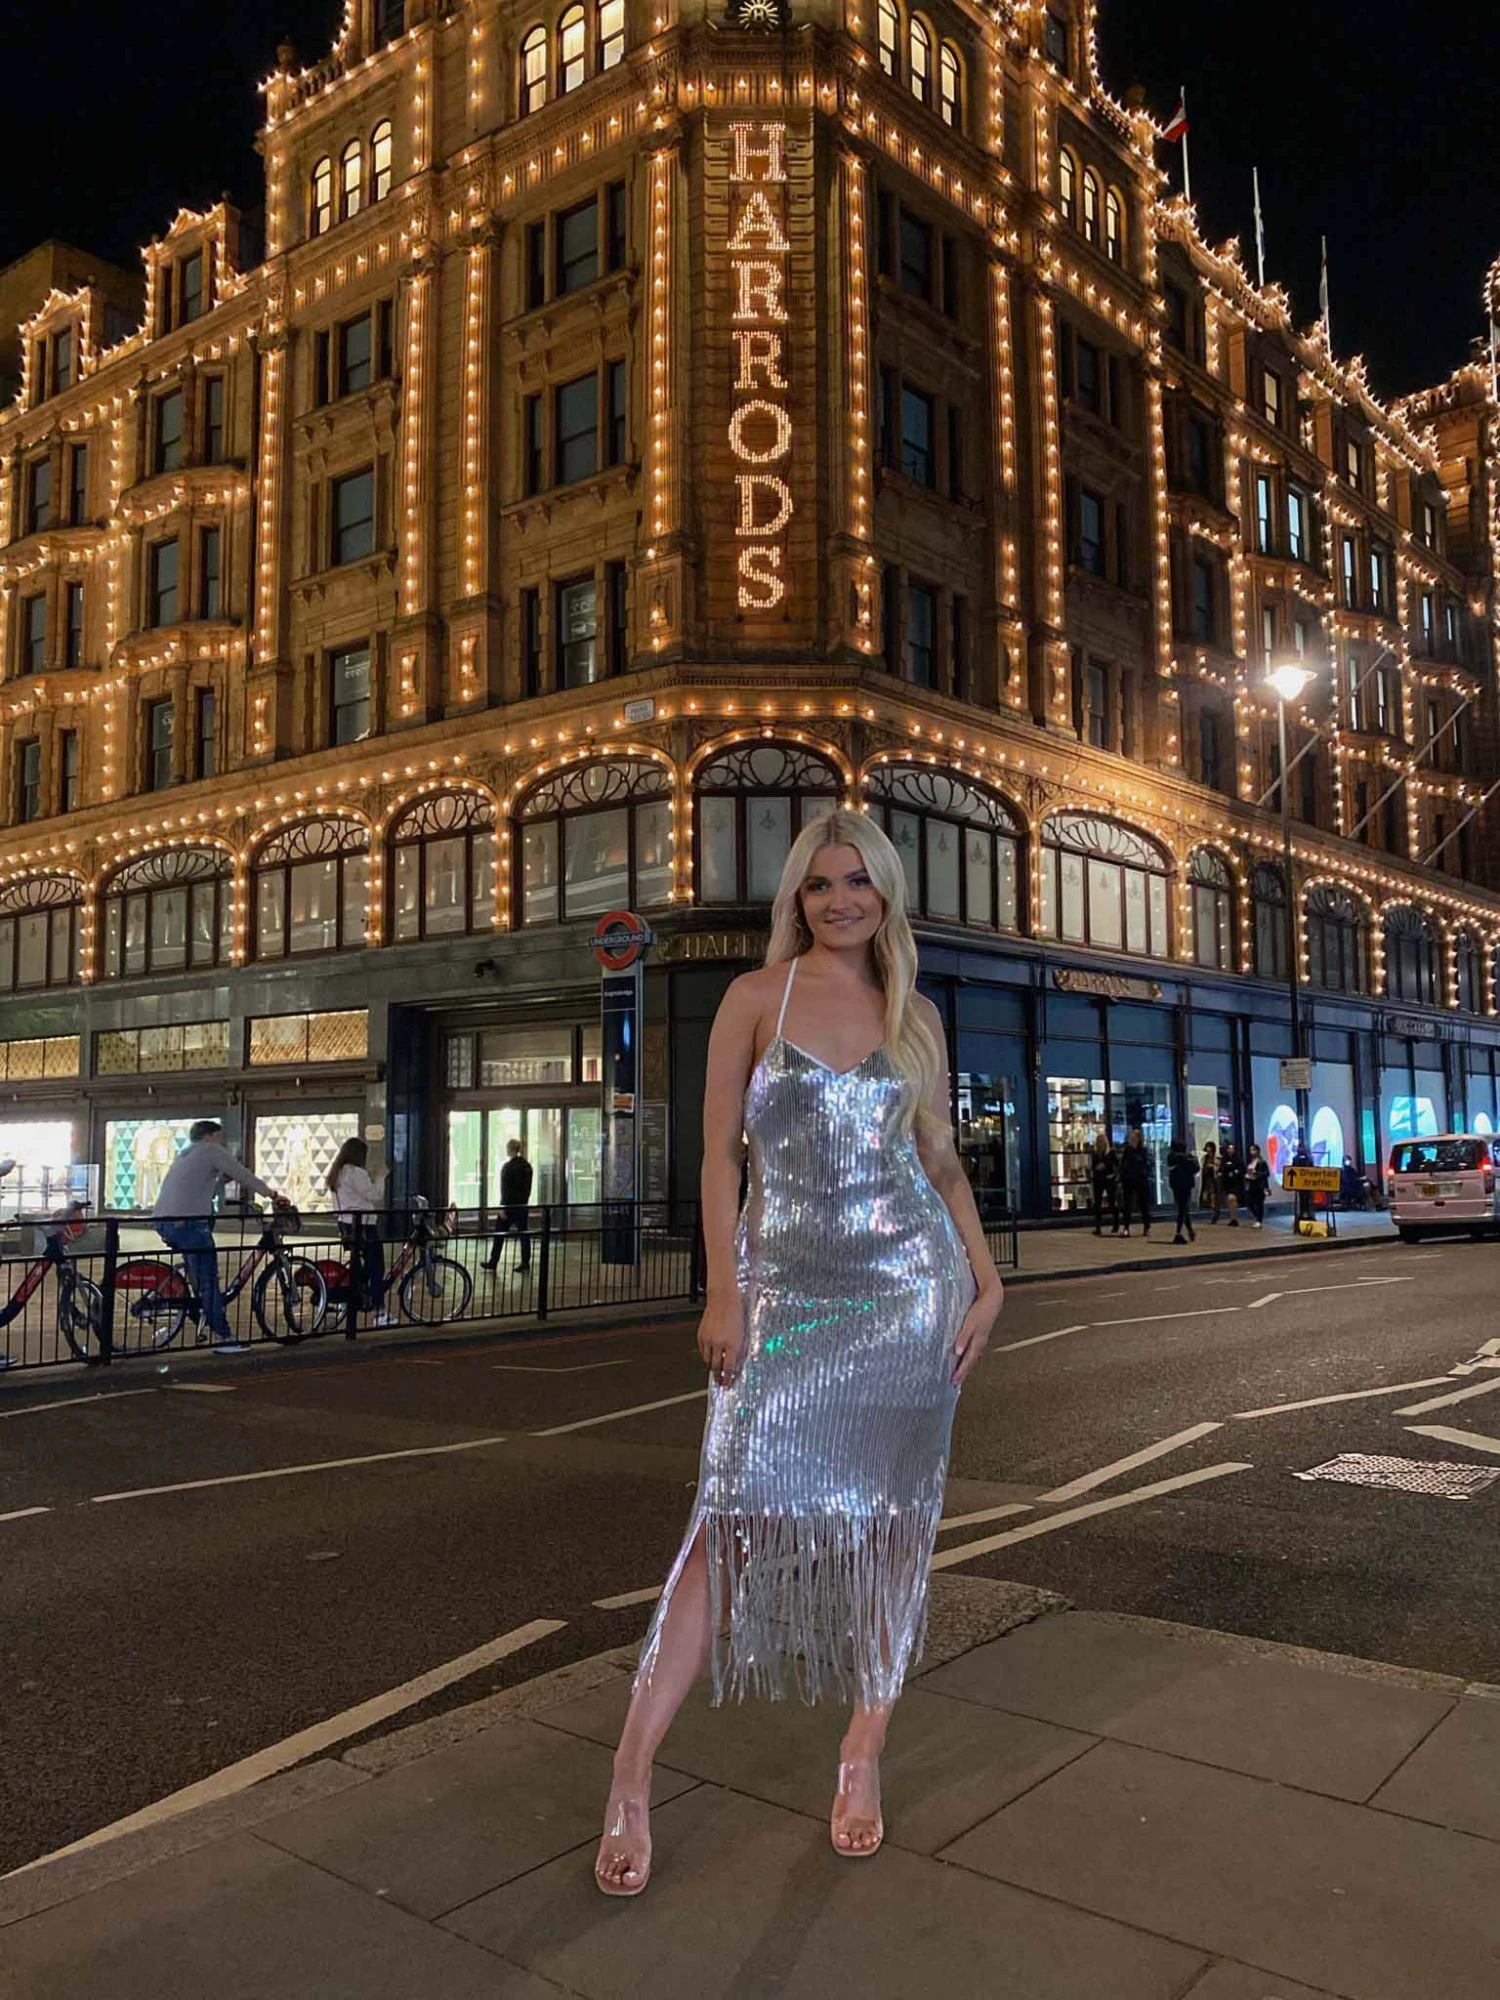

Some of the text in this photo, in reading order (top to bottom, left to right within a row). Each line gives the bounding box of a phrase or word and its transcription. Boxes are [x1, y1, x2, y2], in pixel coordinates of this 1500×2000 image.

[727, 122, 793, 608] HARRODS
[591, 932, 645, 946] UNDERGROUND
[1300, 1168, 1338, 1177] Diverted
[1304, 1178, 1332, 1187] traffic
